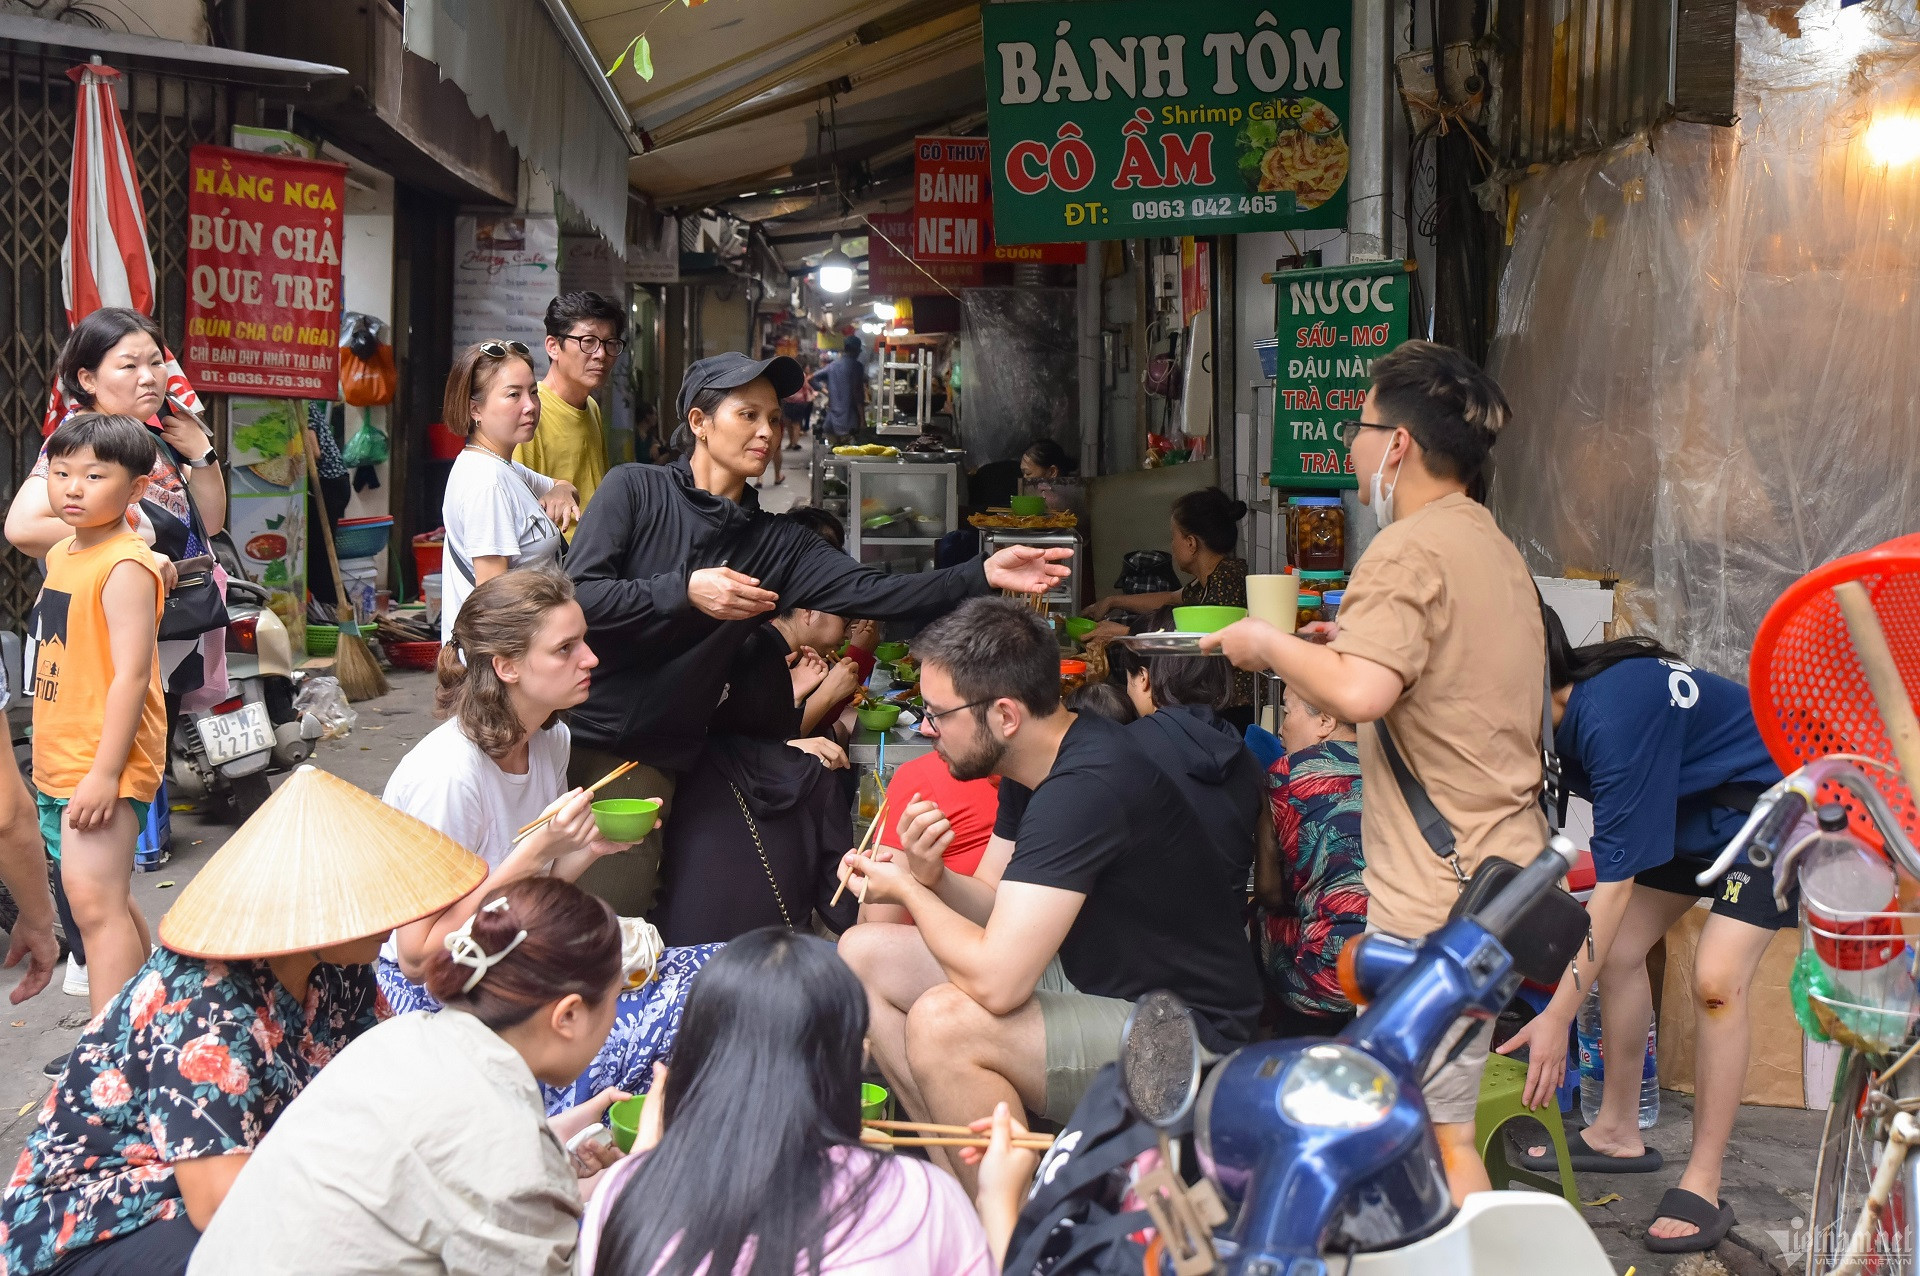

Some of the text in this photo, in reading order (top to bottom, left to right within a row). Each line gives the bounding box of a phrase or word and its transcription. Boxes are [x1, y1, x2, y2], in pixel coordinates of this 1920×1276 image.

[997, 10, 1344, 105] BÁNH TÔM
[1161, 101, 1303, 127] Shrimp Cake
[920, 143, 942, 161] CÔ
[1005, 107, 1217, 195] CÔ ẦM
[196, 158, 338, 212] HẰNG NGA
[919, 167, 979, 204] BÁNH
[1064, 195, 1277, 226] ĐT: 0963 042 465
[189, 207, 340, 266] BÚN CHẢ
[918, 217, 978, 255] NEM
[191, 265, 335, 312] QUE TRE
[188, 315, 231, 337] (BÚN
[272, 321, 294, 343] CÔ
[297, 326, 336, 348] NGA)
[1296, 321, 1336, 348] SẤU
[1351, 323, 1389, 347] MƠ
[212, 345, 236, 364] BÁN
[239, 350, 260, 365] DUY
[1288, 355, 1331, 384] ĐẬU
[1336, 355, 1373, 378] NÀ
[228, 372, 322, 389] 0936.759.390
[1282, 386, 1367, 410] TRÀ CHA
[1290, 418, 1328, 440] TRÀ
[1300, 449, 1340, 474] TRÀ
[1722, 879, 1743, 904] M
